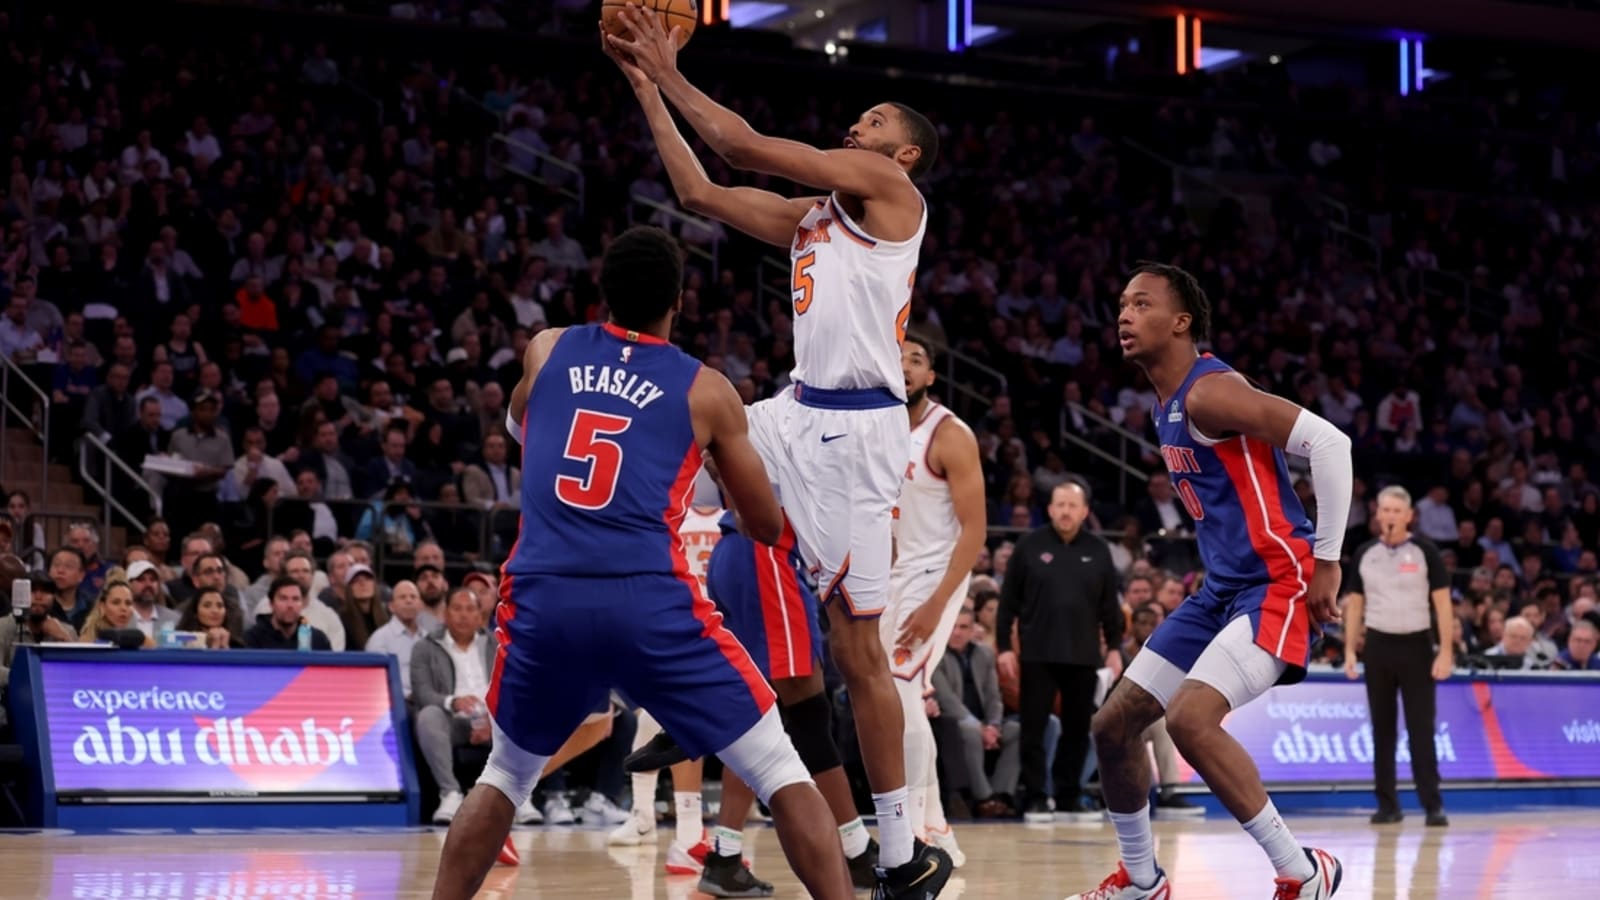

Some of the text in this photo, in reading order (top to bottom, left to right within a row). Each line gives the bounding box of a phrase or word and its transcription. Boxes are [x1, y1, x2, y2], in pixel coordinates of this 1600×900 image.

[568, 365, 664, 409] BEASLEY
[555, 408, 632, 510] 5
[73, 686, 226, 716] experience
[1266, 699, 1367, 722] experience
[72, 716, 187, 766] abu
[1272, 722, 1348, 764] abu
